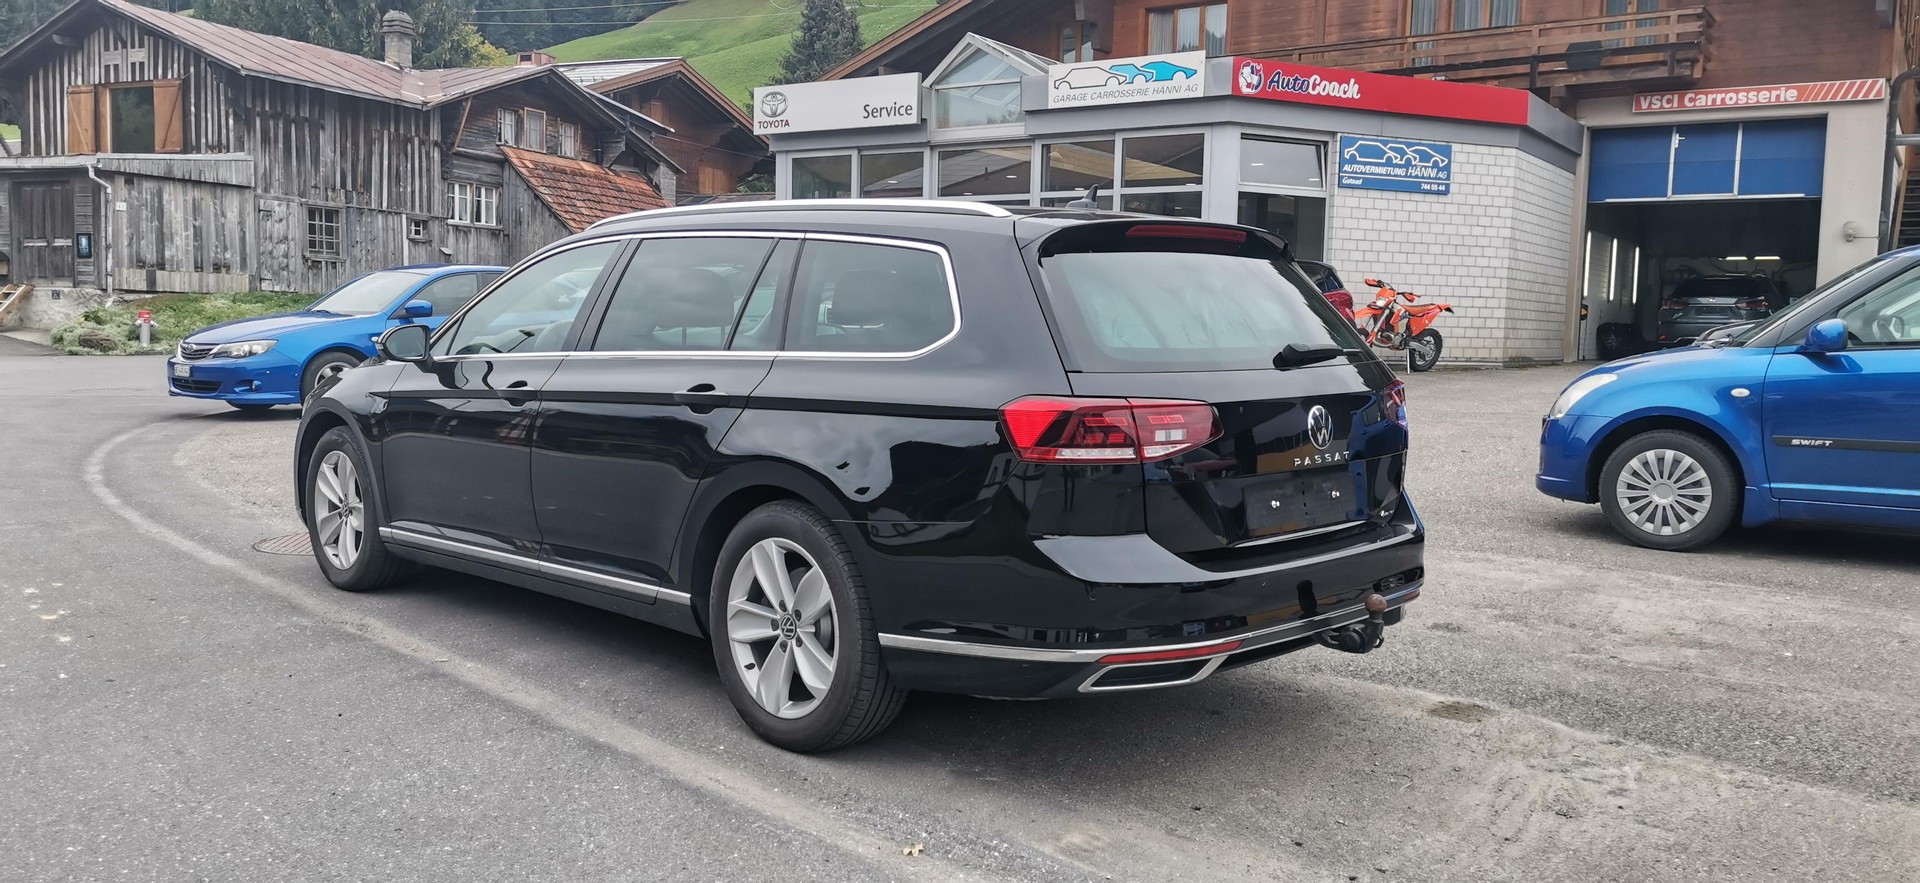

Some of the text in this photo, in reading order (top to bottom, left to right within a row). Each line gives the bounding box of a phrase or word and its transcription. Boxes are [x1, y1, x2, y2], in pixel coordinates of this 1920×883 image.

[1266, 69, 1361, 99] AutoCoach
[1053, 83, 1199, 104] GARAGE CARROSSERIE HÄNNI AG
[1639, 87, 1799, 110] VSCI Carrosserie
[862, 101, 914, 119] Service
[757, 119, 791, 130] TOYOTA
[1343, 164, 1448, 179] AUTOVERMIETUNG HÄNNI AG
[1342, 176, 1363, 185] Gstaad
[1421, 183, 1430, 191] 744
[1790, 438, 1834, 447] SWIFT
[1293, 450, 1350, 467] PASSAT
